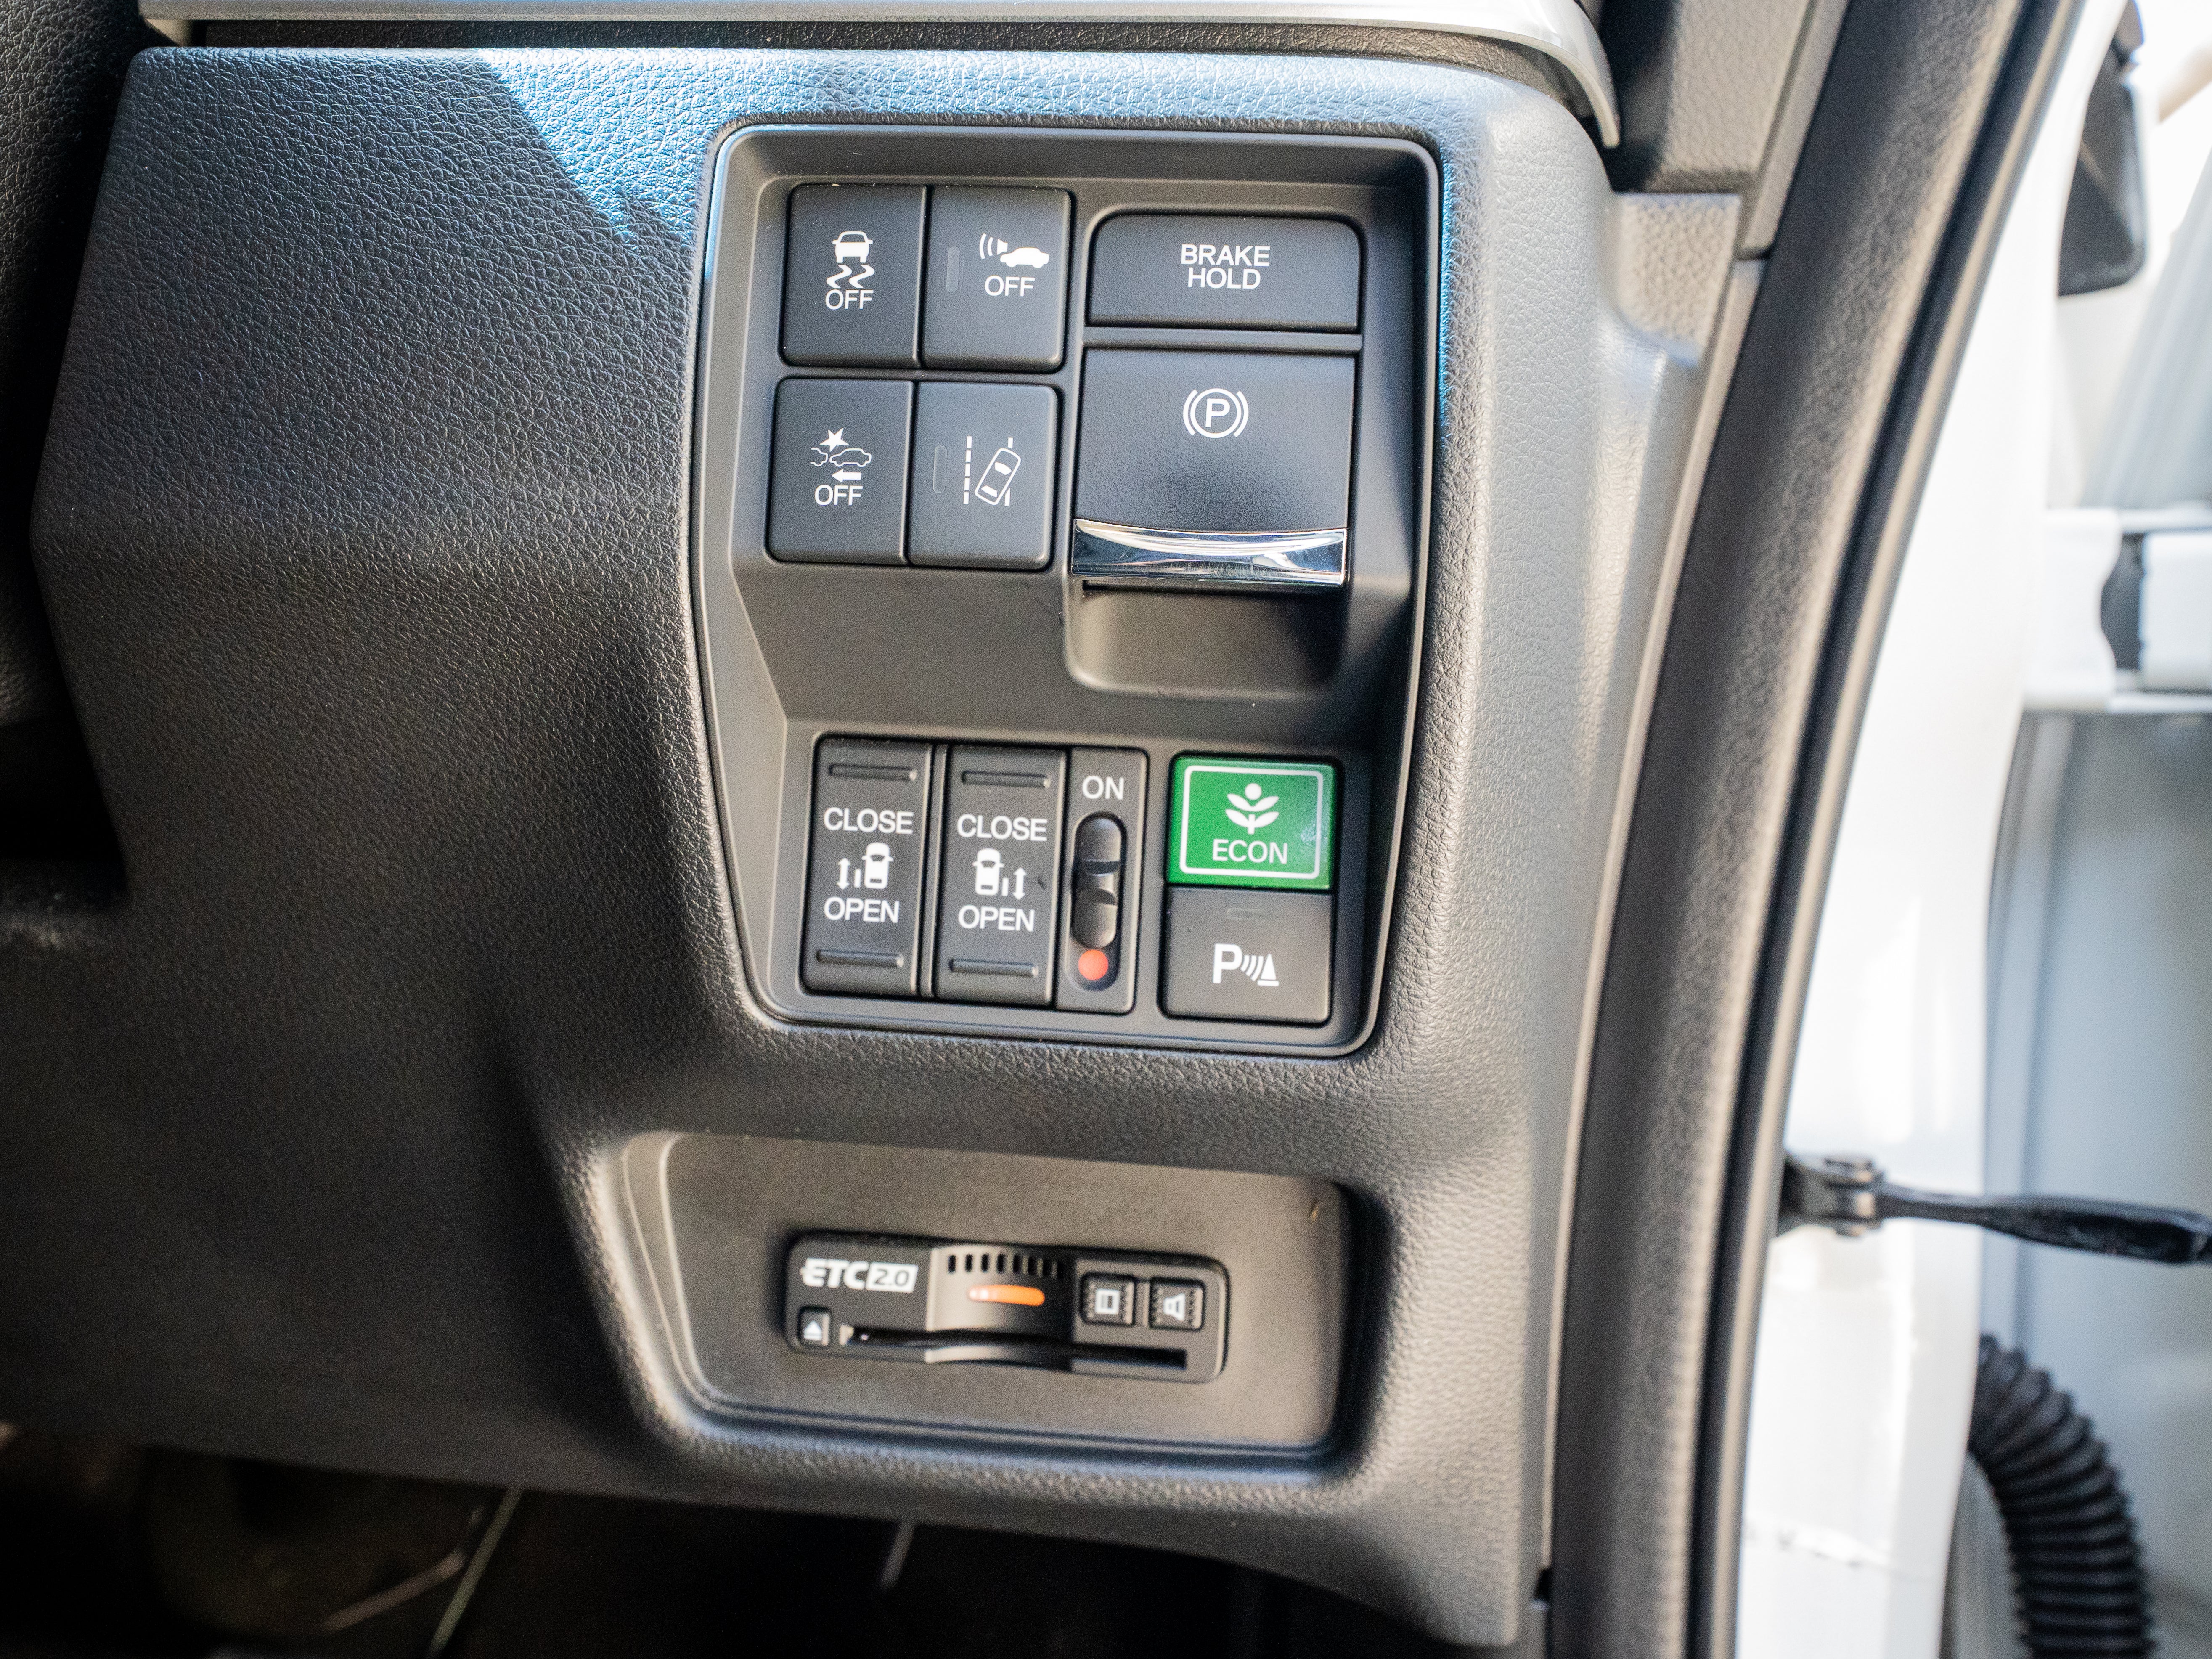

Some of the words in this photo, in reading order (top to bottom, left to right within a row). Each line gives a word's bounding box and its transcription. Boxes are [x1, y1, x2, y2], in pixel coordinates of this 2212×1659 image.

[1180, 244, 1271, 267] BRAKE
[984, 275, 1036, 297] OFF
[1187, 267, 1261, 289] HOLD
[825, 289, 874, 310] OFF
[1205, 398, 1231, 428] P
[814, 484, 864, 506] OFF
[1082, 775, 1124, 800] ON
[823, 806, 914, 835] CLOSE
[956, 814, 1048, 842] CLOSE
[1212, 838, 1288, 864] ECON
[824, 896, 900, 924] OPEN
[958, 904, 1035, 932] OPEN
[1212, 943, 1243, 984] P
